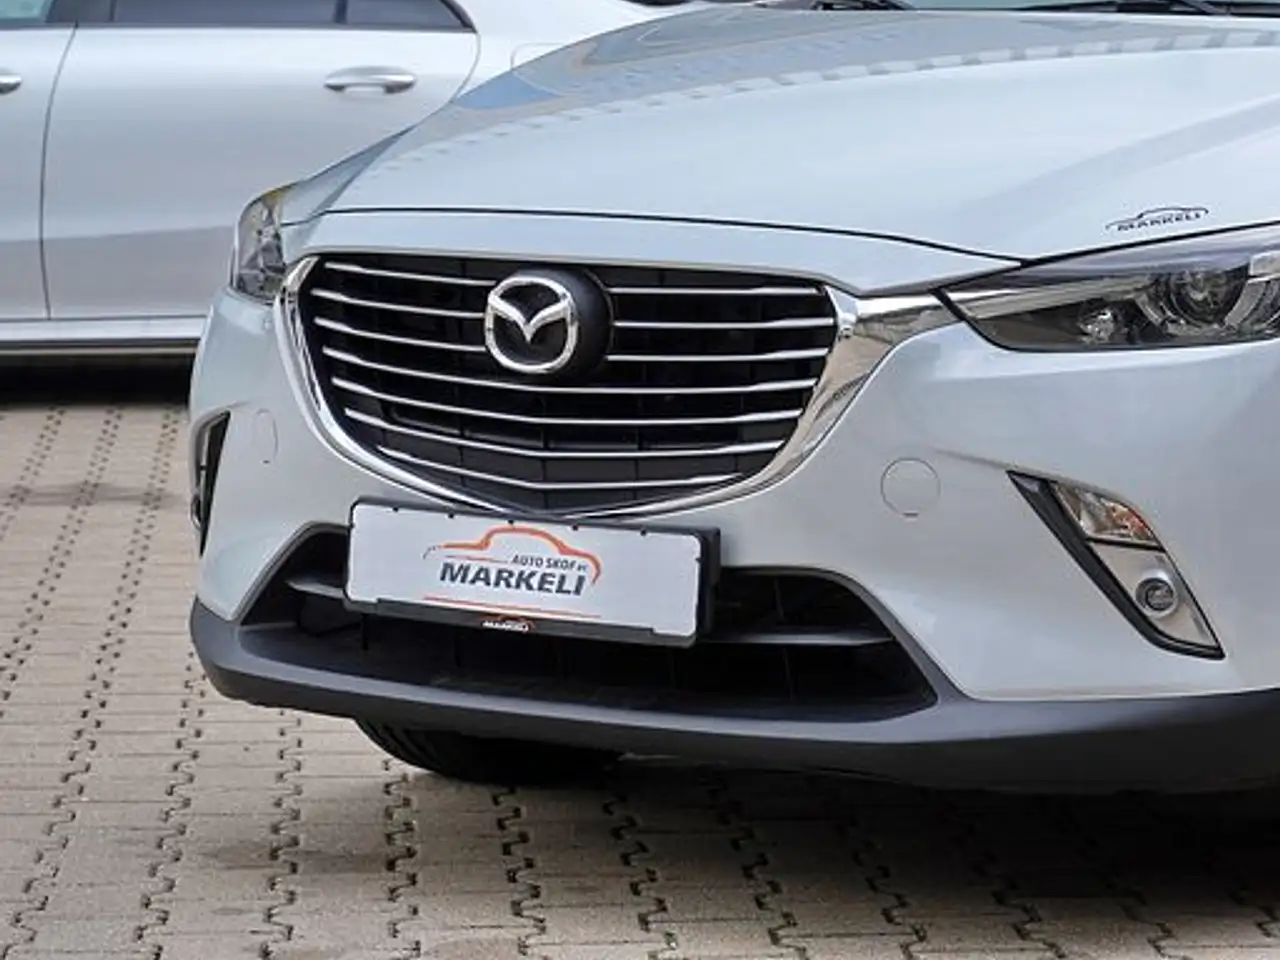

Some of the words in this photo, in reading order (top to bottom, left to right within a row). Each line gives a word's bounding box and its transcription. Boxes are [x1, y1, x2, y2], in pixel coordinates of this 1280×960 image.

[511, 554, 544, 569] AUTO
[545, 557, 576, 572] SKOF
[439, 561, 586, 597] MARKELI
